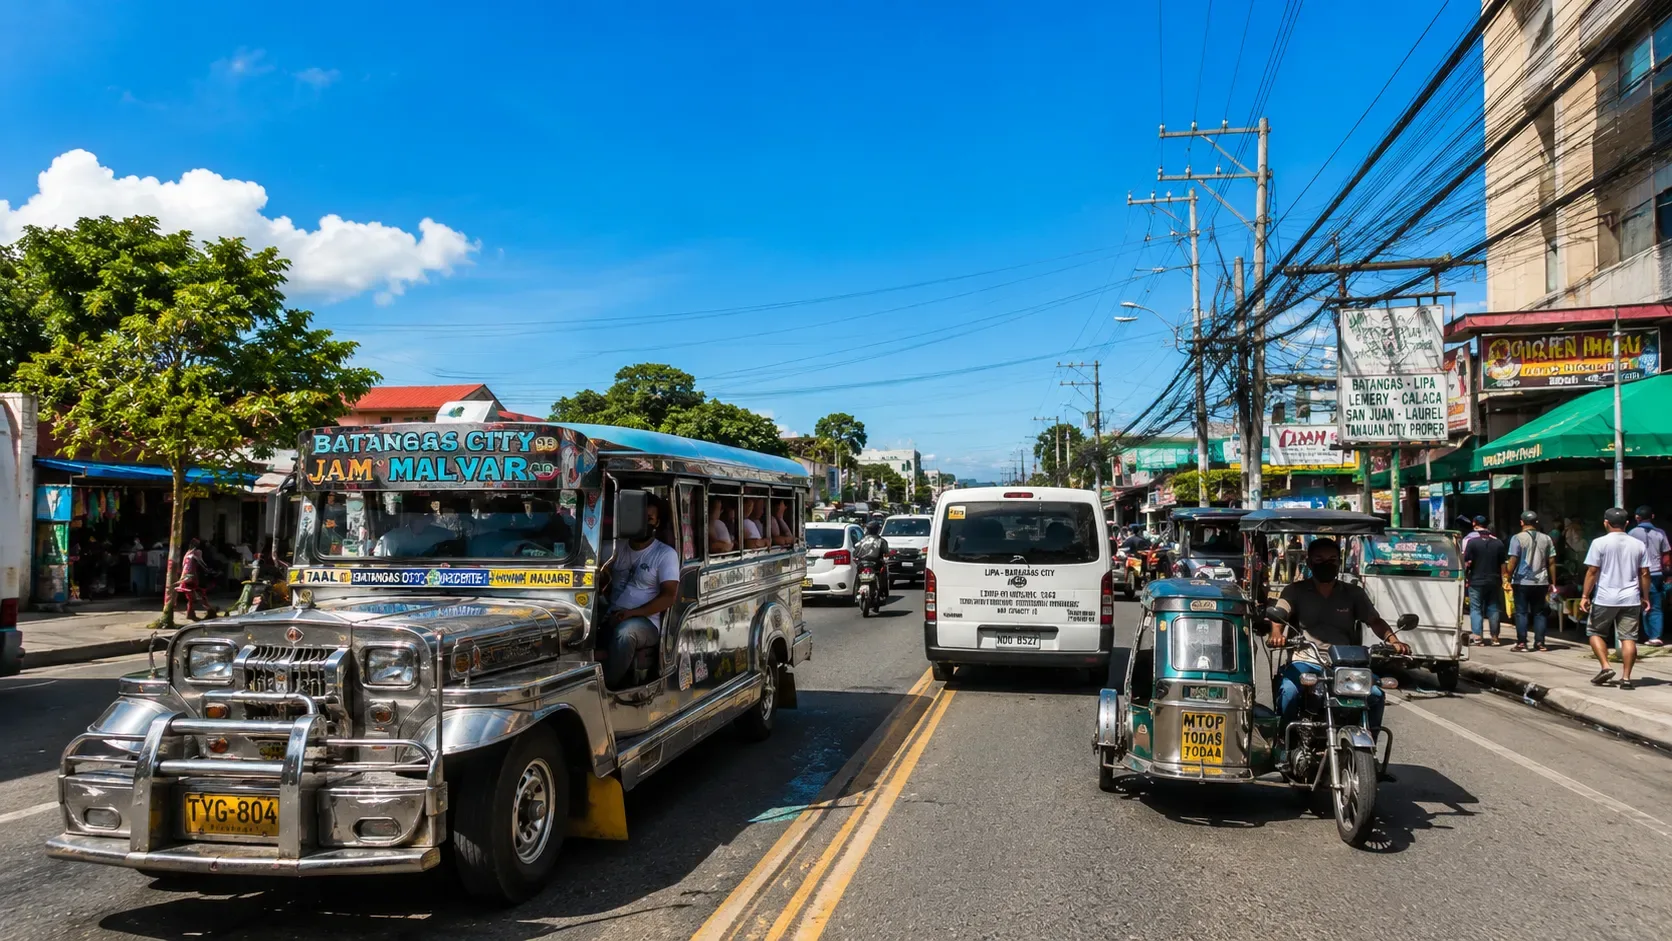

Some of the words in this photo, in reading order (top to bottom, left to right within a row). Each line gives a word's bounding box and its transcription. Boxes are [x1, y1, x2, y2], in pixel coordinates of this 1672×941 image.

[1352, 377, 1404, 391] BATANGAS
[1414, 377, 1436, 390] LIPA
[1349, 393, 1389, 406] LEMERY
[1402, 391, 1443, 405] CALACA
[1346, 409, 1365, 421] SAN
[1369, 407, 1395, 421] JUAN
[1405, 407, 1444, 420] LAUREL
[1388, 423, 1406, 436] CITY
[1410, 422, 1445, 437] PROPER
[466, 430, 536, 453] CITY
[308, 457, 374, 486] JAM
[388, 456, 530, 483] MALVAR
[984, 568, 1000, 577] LIPA
[1040, 568, 1056, 577] CITY
[1183, 713, 1224, 730] MTOP
[1183, 731, 1222, 746] TODAS
[187, 798, 278, 825] TYG-804
